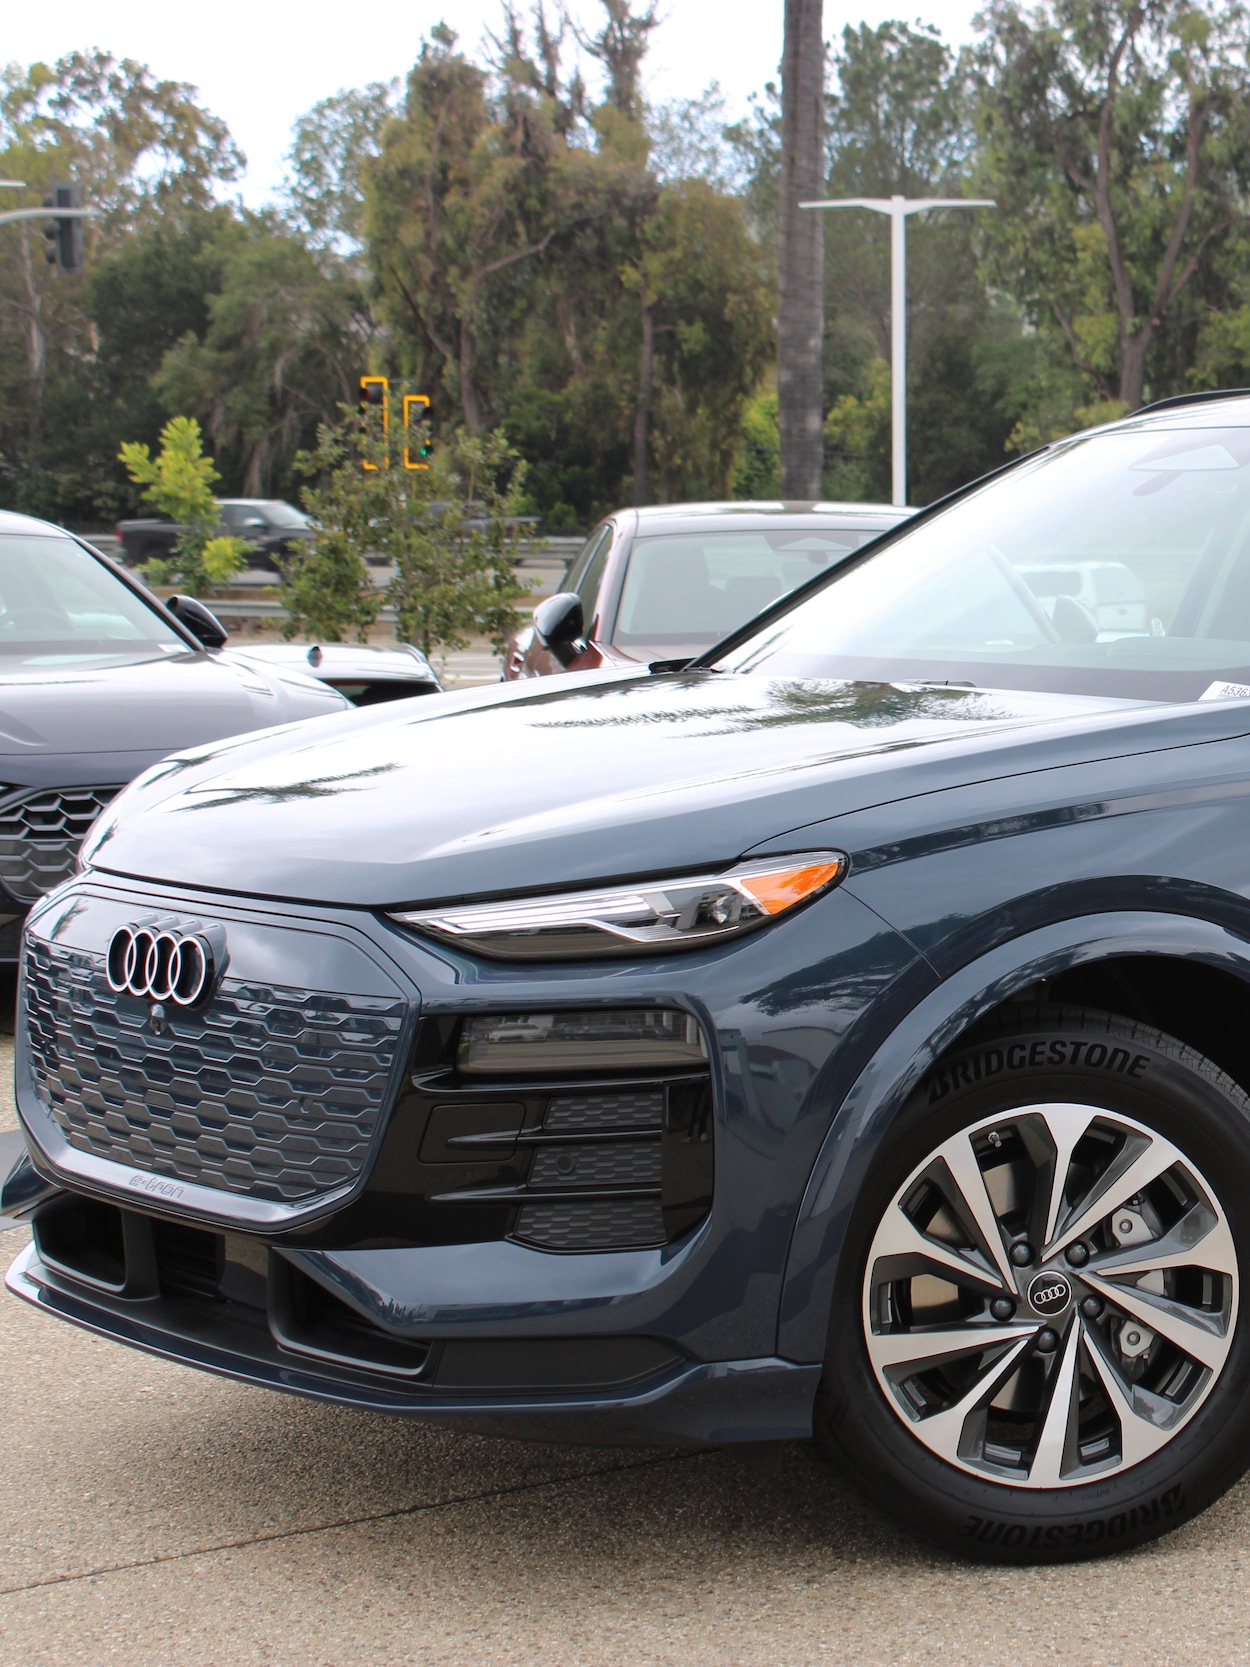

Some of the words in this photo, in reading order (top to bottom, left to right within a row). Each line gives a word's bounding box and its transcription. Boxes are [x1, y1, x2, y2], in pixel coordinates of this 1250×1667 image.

[924, 1040, 1151, 1105] BRIDGESTONE
[129, 1174, 186, 1198] e-tron
[961, 1482, 1187, 1549] BRIDGESTONE
